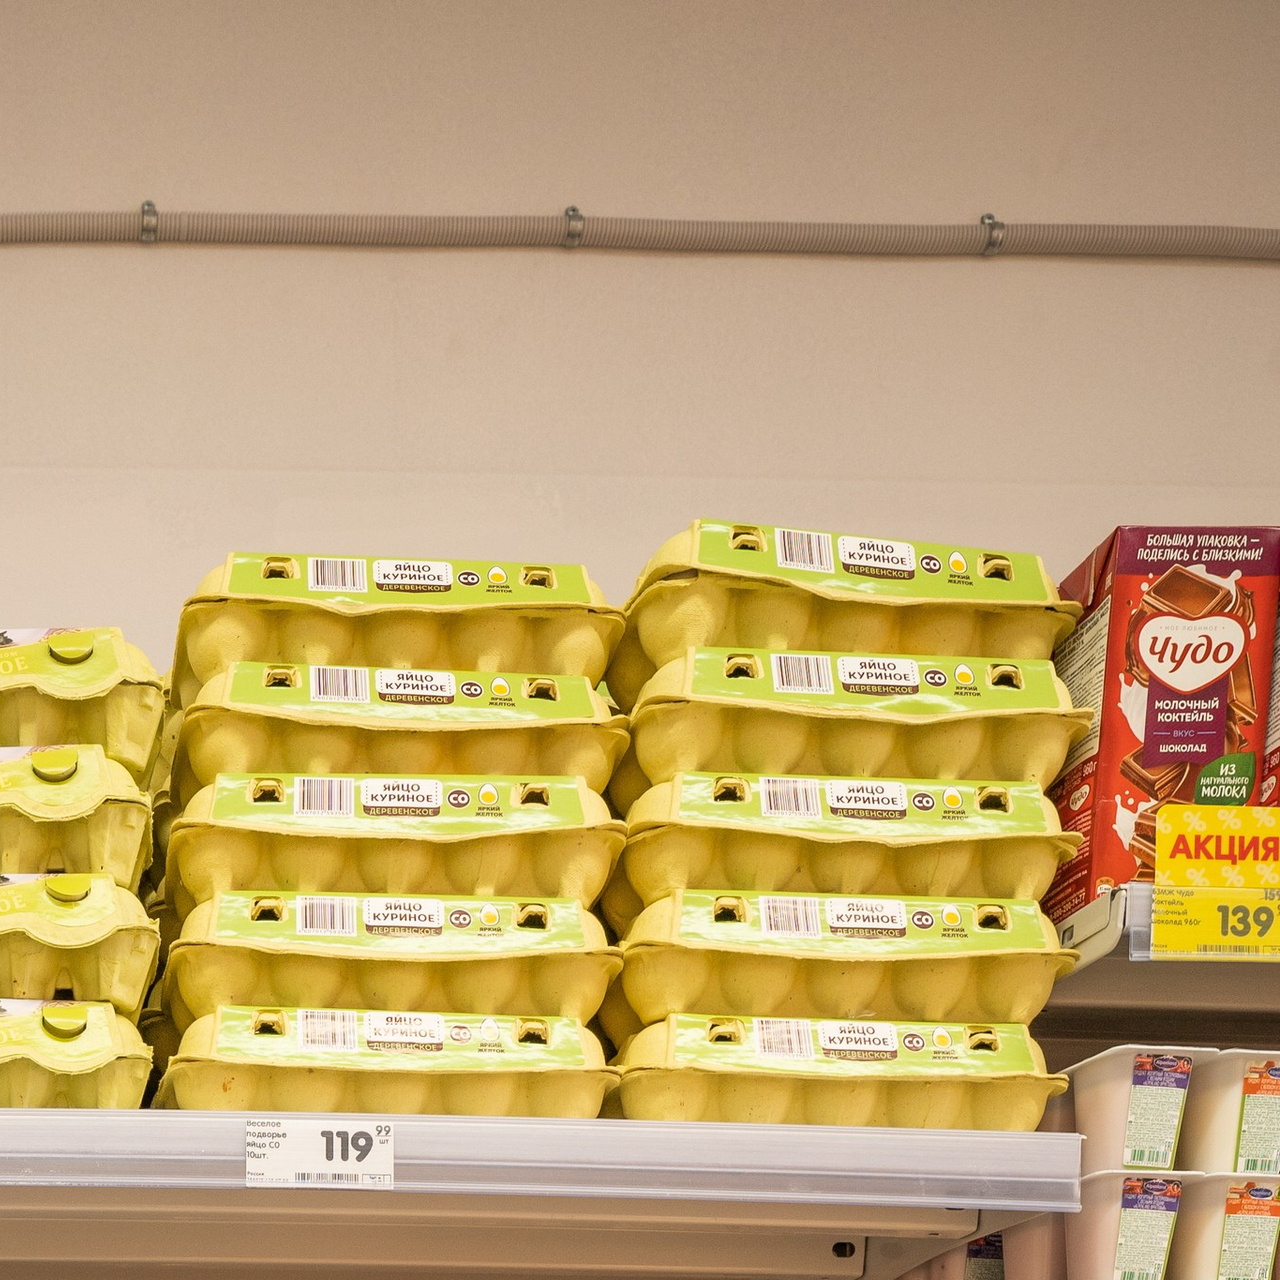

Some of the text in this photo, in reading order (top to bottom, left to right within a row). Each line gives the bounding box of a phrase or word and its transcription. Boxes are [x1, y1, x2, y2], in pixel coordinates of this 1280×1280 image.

[1146, 534, 1248, 548] БОЛЬШАЯ УПАКОВКА
[859, 541, 894, 554] ЯЙЦО
[848, 552, 907, 566] КУРИНОЕ
[1137, 548, 1190, 562] ПОДЕЛИСЬ
[1202, 547, 1263, 562] БЛИЗКИМИ!
[395, 562, 431, 572] ЯЙЦО
[848, 565, 910, 578] ДЕРЕВЕНСКОЕ
[383, 572, 444, 582] КУРИНОЕ
[859, 660, 896, 671] ЯЙЦО
[848, 672, 911, 682] КУРИНОЕ
[849, 684, 913, 694] ДЕРЕВЕНСКОЕ
[1154, 697, 1219, 710] МОЛОЧНЫЙ
[1157, 710, 1214, 722] КОКТЕЙЛЬ
[1173, 729, 1195, 737] ВКУС
[1159, 744, 1207, 753] ШОКОЛАД
[1220, 763, 1236, 776] ИЗ
[1200, 776, 1249, 785] НАТУРАЛЬНОГО
[383, 782, 420, 792] ЯЙЦО
[1201, 785, 1247, 799] МОЛОКА
[370, 794, 433, 803] КУРИНОЕ
[1169, 834, 1280, 865] АКЦИЯ
[1217, 905, 1275, 937] 139
[375, 1125, 391, 1135] 99
[246, 1141, 267, 1149] яйцо
[320, 1130, 373, 1162] 119
